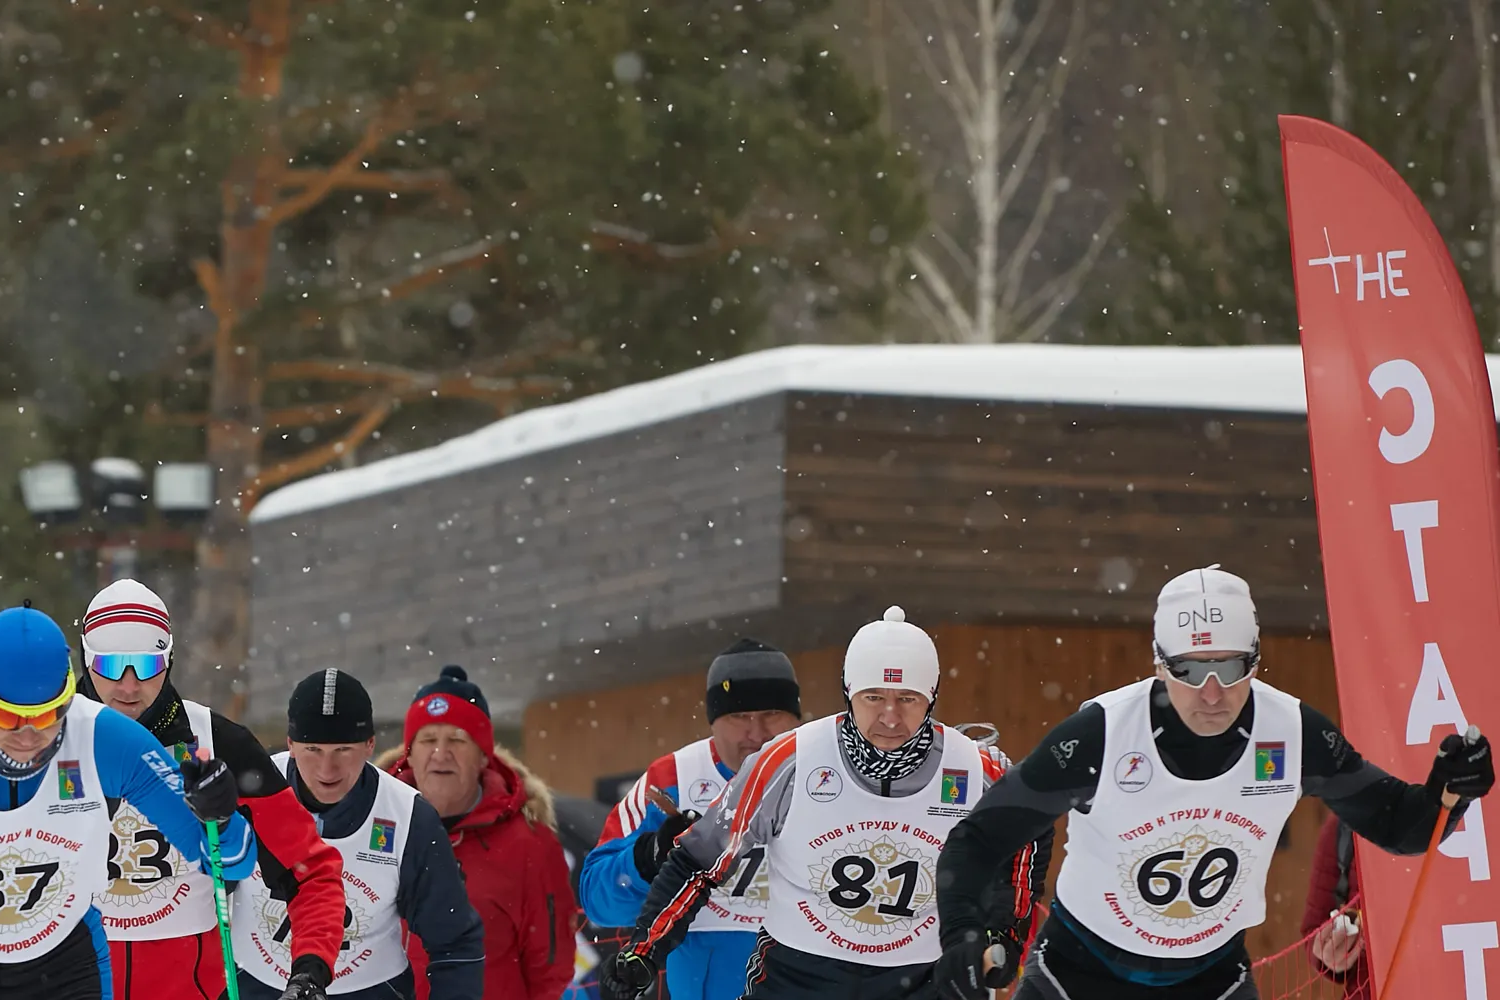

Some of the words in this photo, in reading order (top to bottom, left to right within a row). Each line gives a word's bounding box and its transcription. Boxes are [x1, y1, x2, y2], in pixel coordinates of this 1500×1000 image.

[1178, 599, 1224, 631] DNB
[25, 828, 33, 838] И
[36, 829, 84, 853] ОБОРОНЕ
[808, 828, 844, 850] ГОТОВ
[858, 821, 899, 832] ТРУДУ
[902, 824, 910, 833] И
[912, 827, 944, 852] ОБОРО
[1118, 823, 1155, 843] ГОТОВ
[1169, 807, 1210, 823] ТРУДУ
[1213, 809, 1222, 819] И
[1224, 812, 1268, 841] ОБОРОНЕ
[341, 871, 381, 904] ОБОРОНЕ
[828, 855, 920, 917] 81
[1136, 847, 1239, 908] 60
[101, 903, 175, 930] стирования
[172, 882, 190, 905] ГТО
[705, 900, 730, 919] ентр
[1103, 891, 1134, 928] Центр
[1134, 922, 1224, 949] тестирования
[797, 900, 827, 933] Центр
[825, 929, 914, 955] тестирования
[913, 915, 936, 938] ГТО
[250, 932, 273, 964] Центр
[351, 948, 373, 968] ГТО
